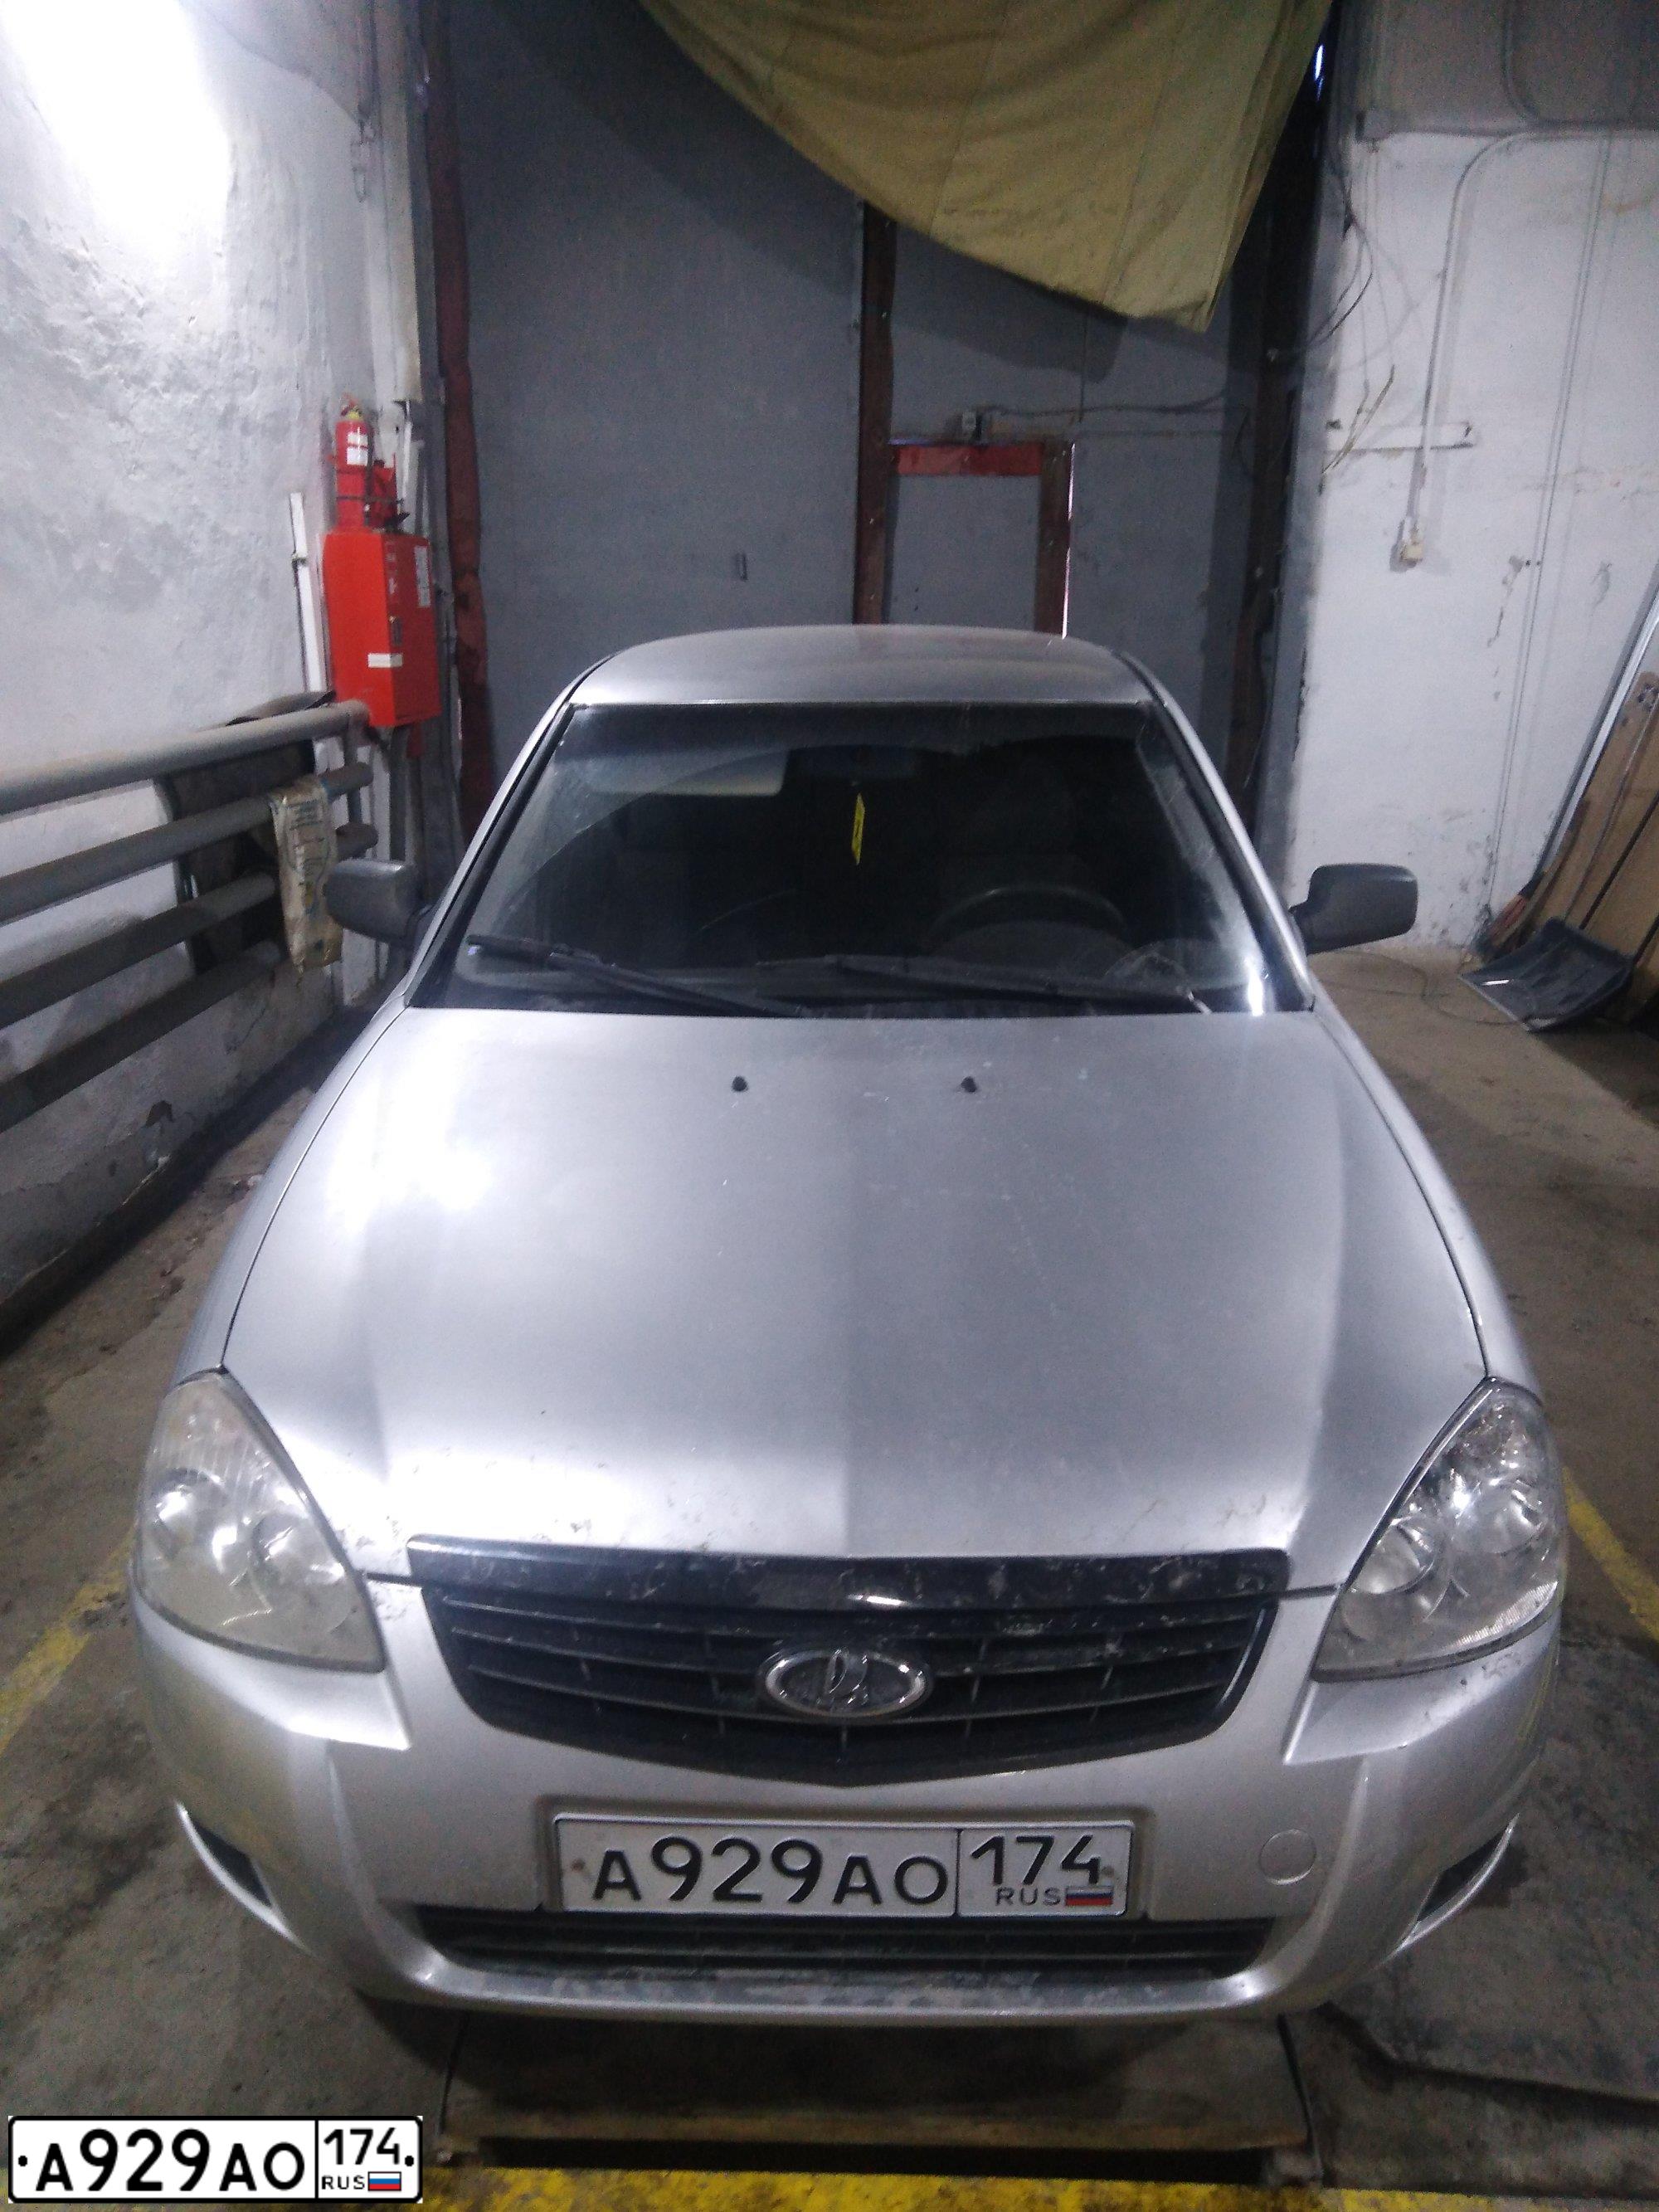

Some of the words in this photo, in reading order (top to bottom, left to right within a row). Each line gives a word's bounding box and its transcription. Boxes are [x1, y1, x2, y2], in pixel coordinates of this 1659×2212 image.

[591, 1834, 950, 1906] A929AO
[970, 1834, 1102, 1885] 174
[995, 1886, 1062, 1907] RUS
